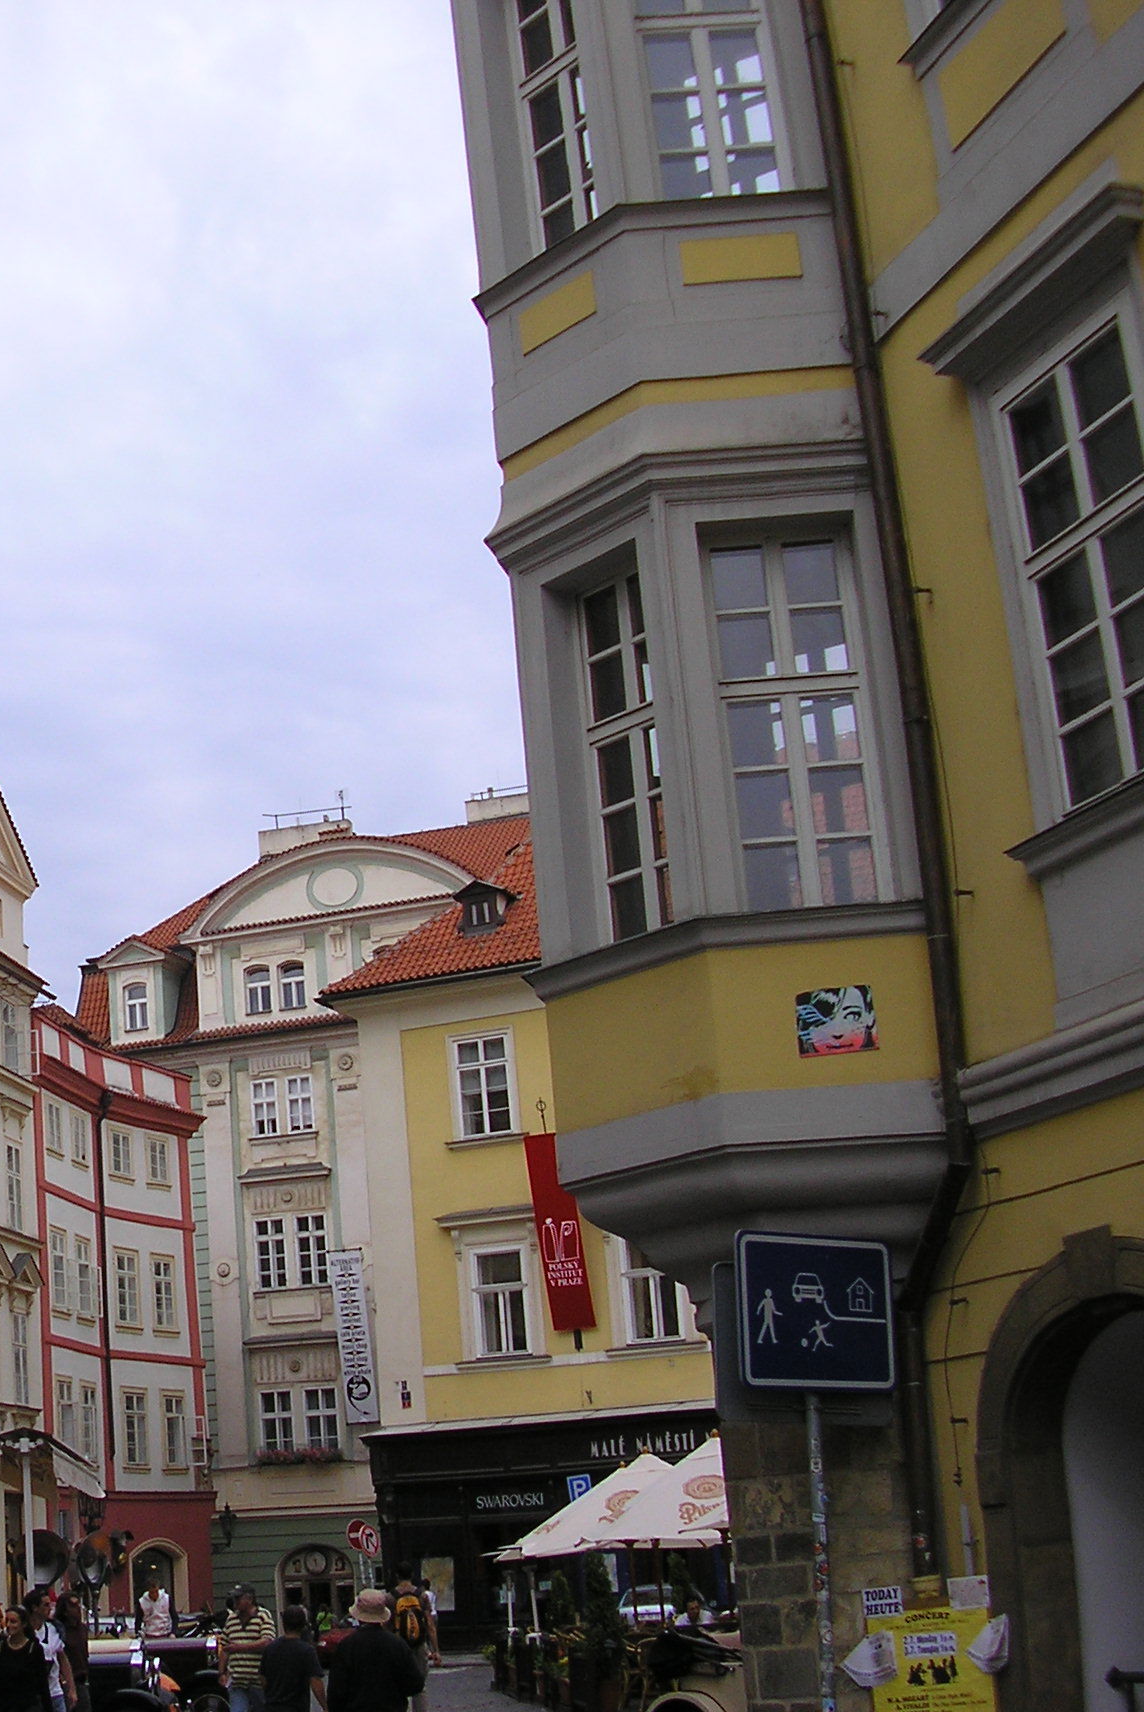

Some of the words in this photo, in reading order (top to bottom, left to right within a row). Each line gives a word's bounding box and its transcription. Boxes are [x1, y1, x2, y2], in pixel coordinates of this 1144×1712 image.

[547, 1268, 584, 1280] INSTITUT
[557, 1277, 584, 1287] PRAZE
[591, 1434, 626, 1458] MALÉ
[476, 1492, 545, 1510] SWAROVSKI
[864, 1587, 899, 1602] TODAY
[865, 1602, 902, 1616] HEUTE
[905, 1611, 950, 1624] CONCERT
